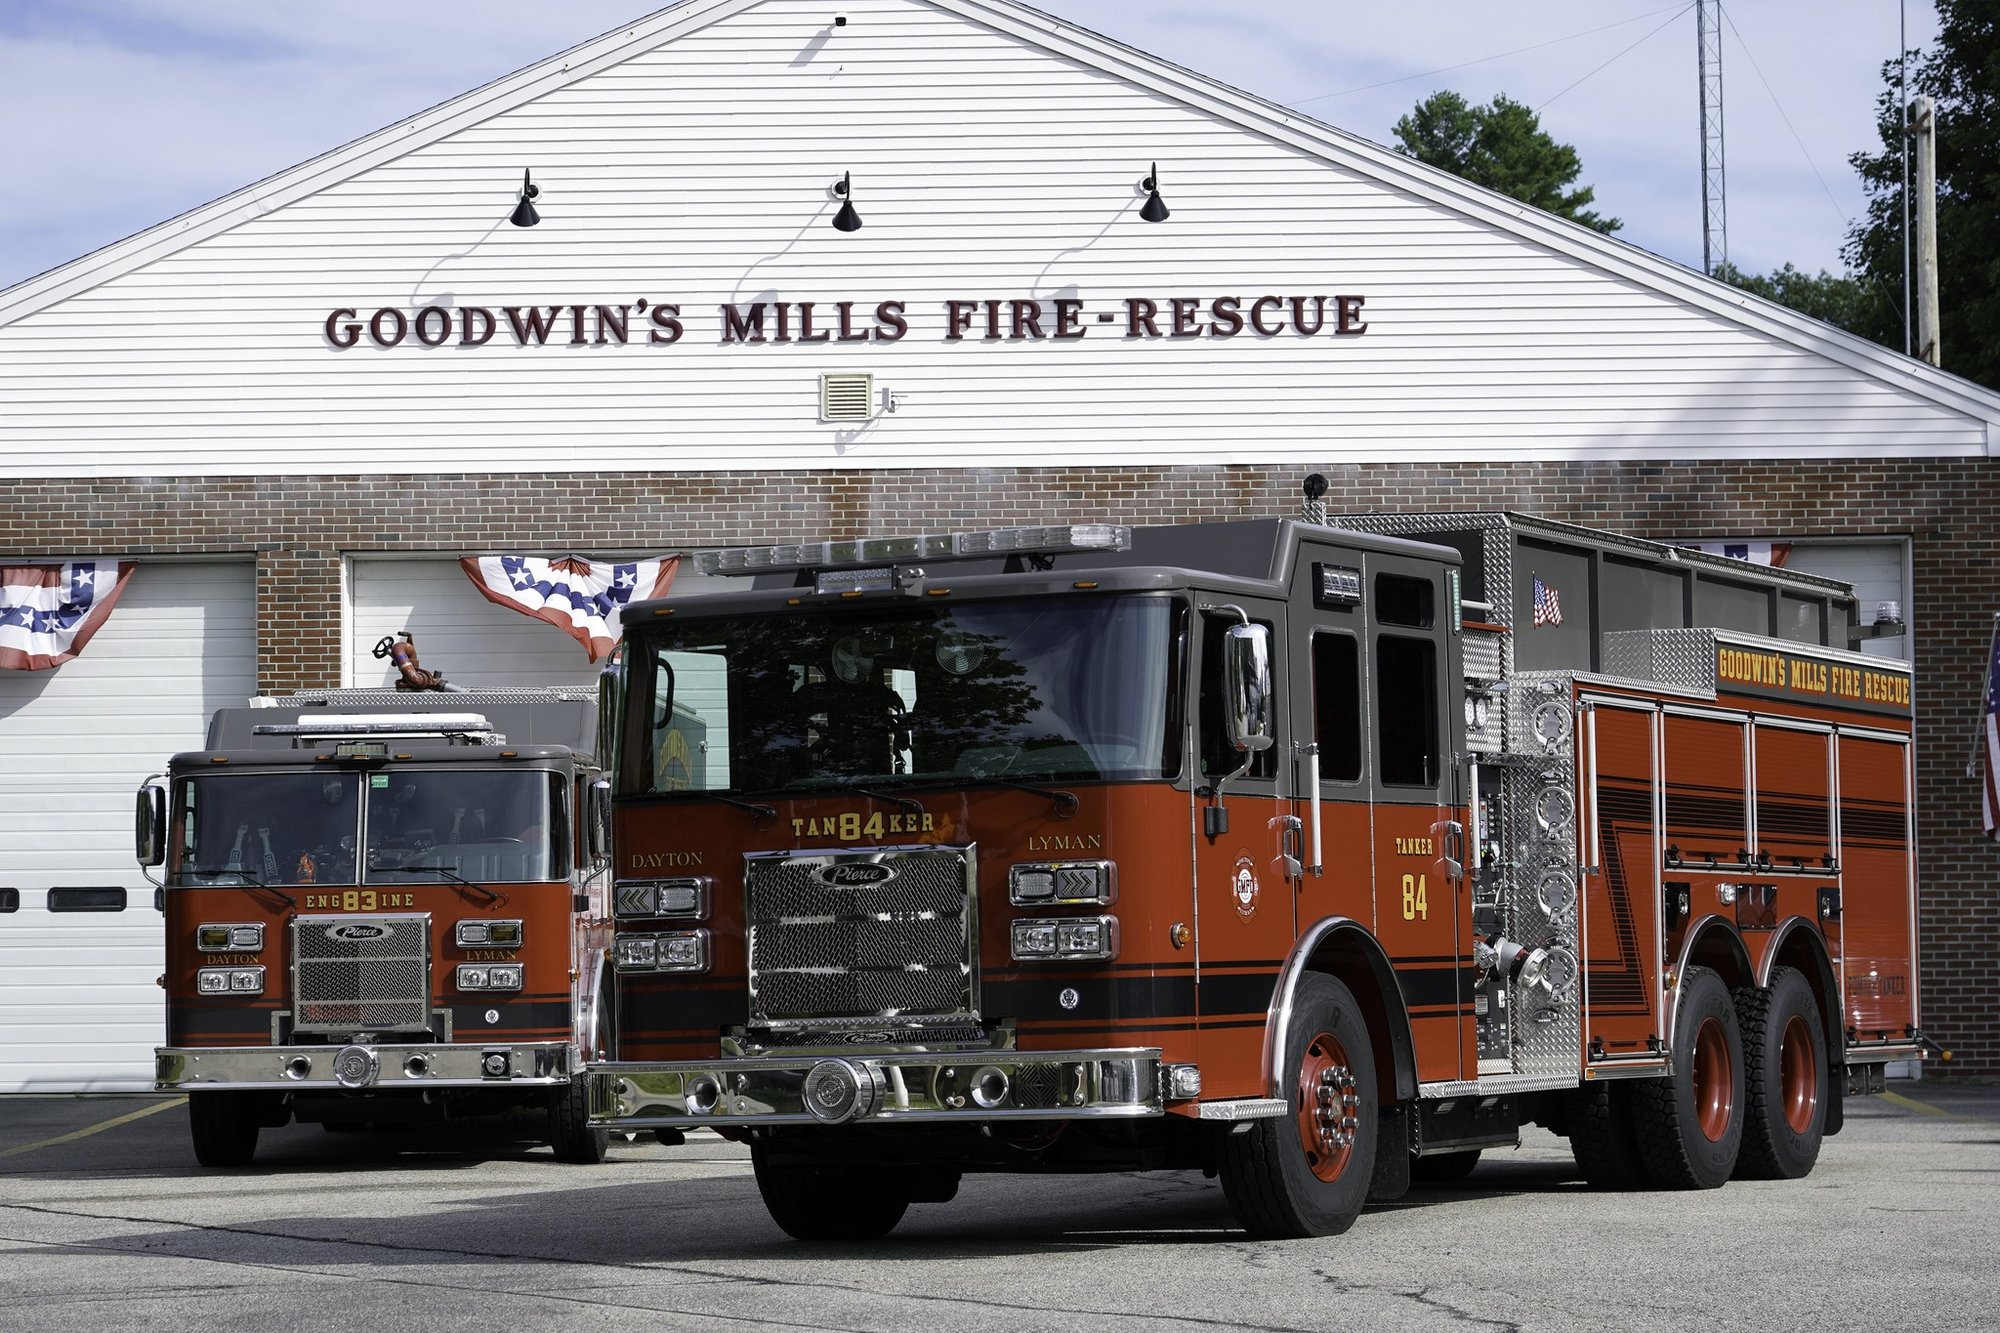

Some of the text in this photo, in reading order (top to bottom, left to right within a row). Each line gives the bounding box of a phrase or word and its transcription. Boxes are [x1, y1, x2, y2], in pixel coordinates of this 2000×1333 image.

[327, 295, 1368, 347] GOODWIN'S MILLS FIRE-RESCUE
[1718, 648, 1911, 706] GOODWIN'S MILLS FIRE RESCUE
[1028, 834, 1102, 852] LYMAN
[1396, 837, 1433, 856] TANKER
[631, 851, 703, 869] DAYTON
[831, 865, 880, 883] Pierce
[1402, 873, 1428, 921] 84
[342, 926, 378, 939] Pierce
[206, 954, 259, 965] DAYTON
[466, 950, 517, 961] LYMAN
